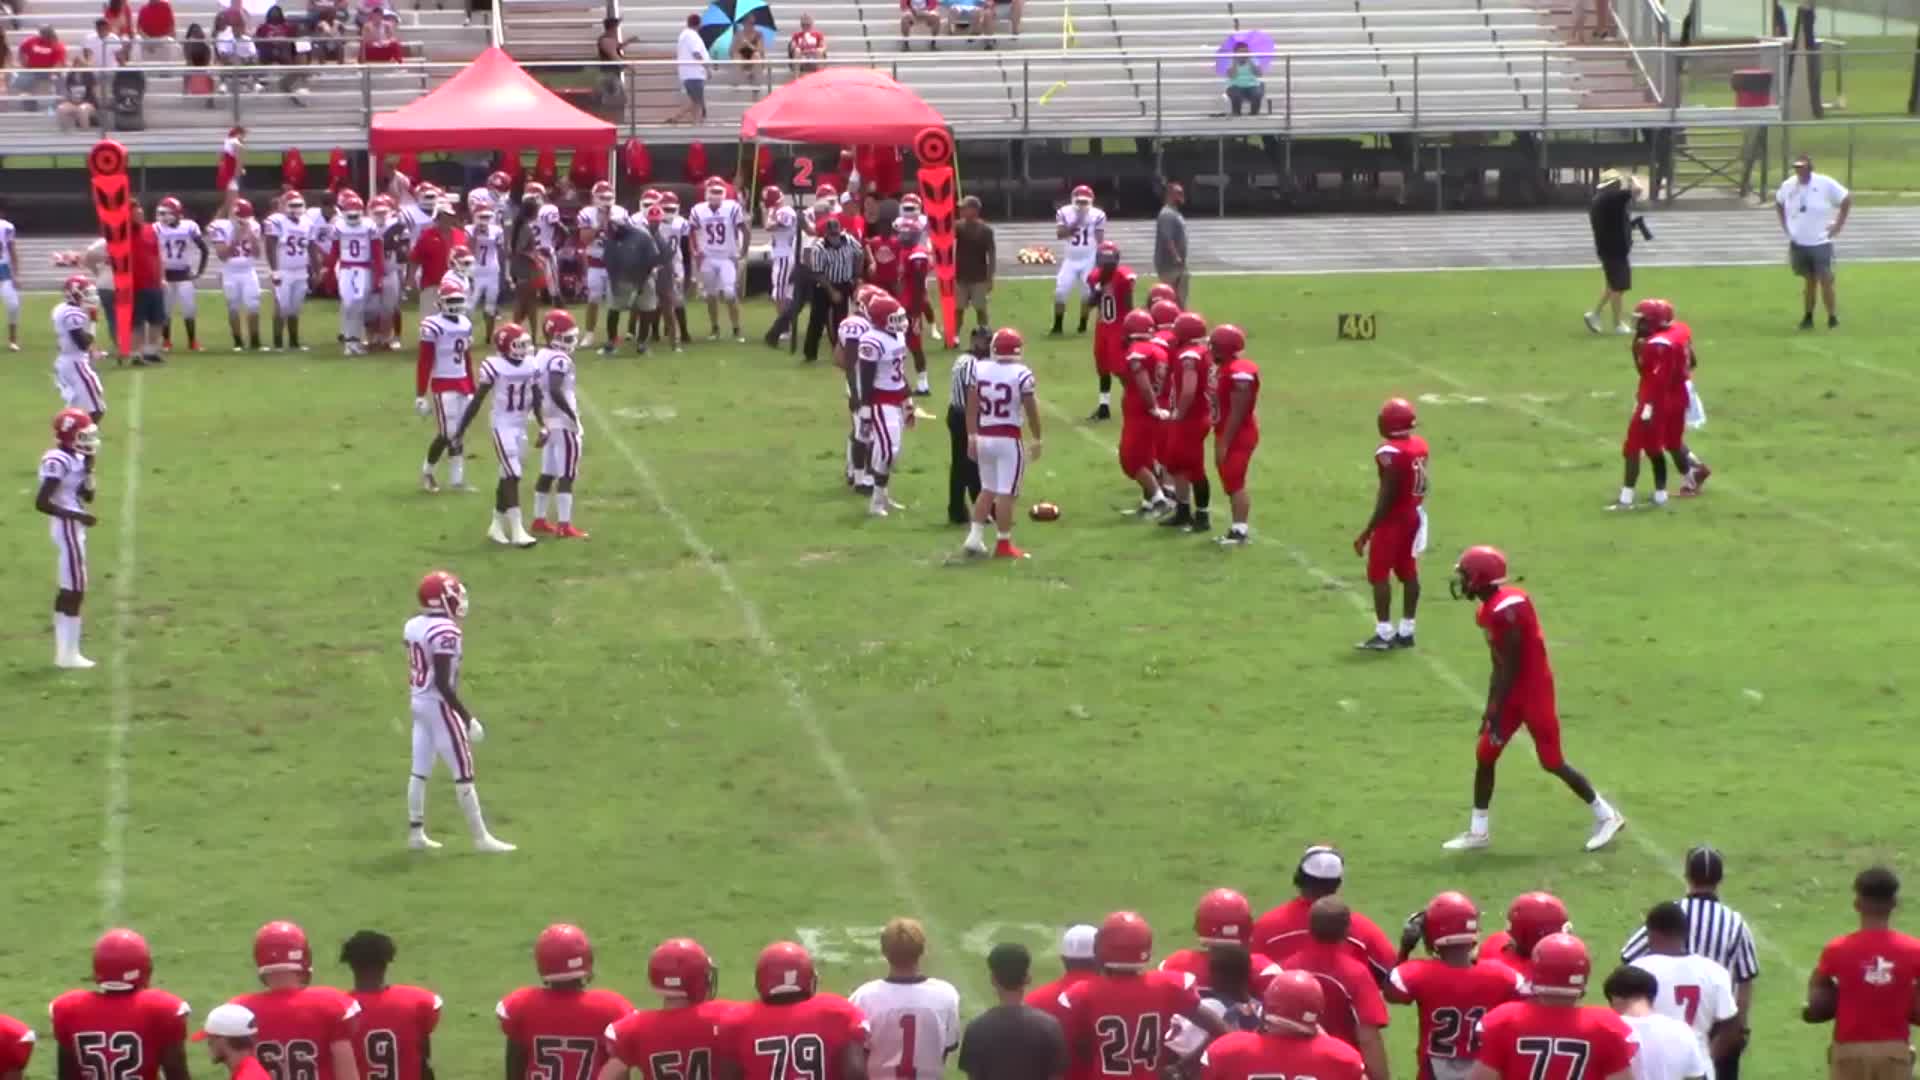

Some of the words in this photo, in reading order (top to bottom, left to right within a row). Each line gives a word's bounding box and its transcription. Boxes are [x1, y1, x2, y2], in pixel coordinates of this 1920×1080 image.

[793, 156, 813, 187] 2
[165, 239, 187, 259] 17
[349, 239, 360, 258] 0
[706, 223, 726, 245] 59
[479, 245, 488, 267] 7
[1343, 314, 1374, 338] 40
[454, 338, 465, 365] 9
[506, 383, 526, 412] 11
[977, 381, 1013, 418] 52
[440, 636, 457, 649] 20
[1674, 984, 1701, 1027] 7
[896, 1014, 917, 1080] 1
[1096, 1012, 1161, 1075] 24
[1427, 1006, 1487, 1058] 21
[74, 1031, 144, 1080] 52
[364, 1028, 400, 1080] 9
[533, 1036, 597, 1080] 57
[755, 1033, 826, 1080] 79
[1517, 1037, 1591, 1080] 77
